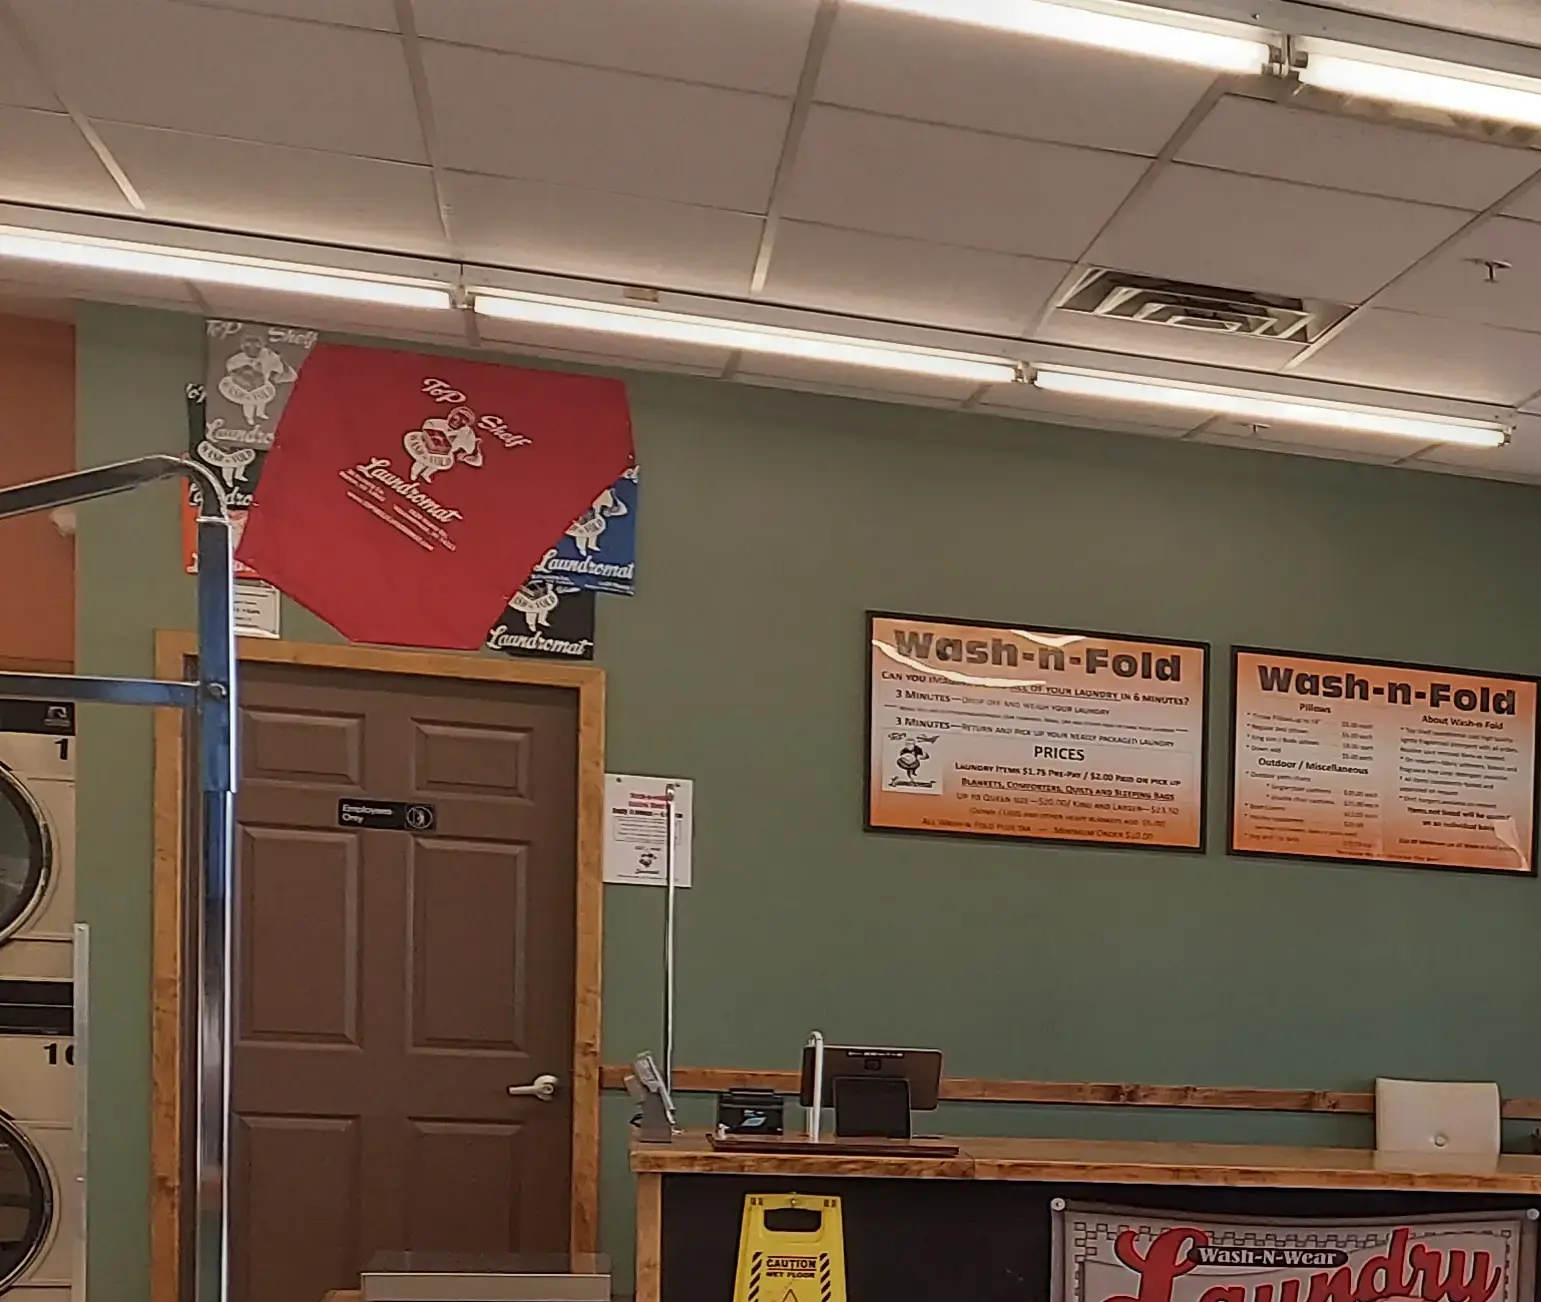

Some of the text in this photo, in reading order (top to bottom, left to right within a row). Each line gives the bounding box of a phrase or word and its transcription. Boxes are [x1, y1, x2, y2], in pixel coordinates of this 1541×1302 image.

[477, 414, 533, 448] Shelf
[356, 457, 465, 523] Laundromat
[533, 549, 635, 580] Laundromat
[487, 625, 594, 656] Laundromat
[893, 630, 1182, 683] Wash-n-Fold
[881, 671, 902, 681] CAN
[905, 674, 927, 683] YOU
[1046, 686, 1072, 696] YOUR
[1074, 688, 1118, 700] LAUNDRY
[1120, 693, 1132, 701] IN
[1133, 692, 1140, 701] 6
[1141, 695, 1190, 706] MINUTES?
[1257, 664, 1517, 716] Wash-n-Fold
[896, 689, 902, 699] 3
[1051, 704, 1073, 713] YOUR
[1074, 706, 1110, 716] LAUNDRY
[1299, 703, 1332, 714] Pillows
[896, 716, 902, 726] 3
[1046, 731, 1068, 740] YOUR
[1098, 735, 1138, 745] PACKAGED
[1139, 738, 1175, 748] LAUNDRY
[1421, 715, 1449, 726] About
[1484, 721, 1504, 730] Fold
[54, 738, 69, 760] 1
[1034, 745, 1086, 762] PRICES
[954, 762, 994, 772] LAUNDRY
[1090, 772, 1114, 781] $2.00
[1258, 757, 1297, 769] Outdoor
[1305, 761, 1369, 775] Miscellaneous
[1153, 791, 1175, 801] BAGS
[342, 804, 393, 815] Employees
[342, 812, 364, 824] Only
[766, 1259, 817, 1268] CAUTION
[1200, 1246, 1338, 1267] Wash-N-Wear
